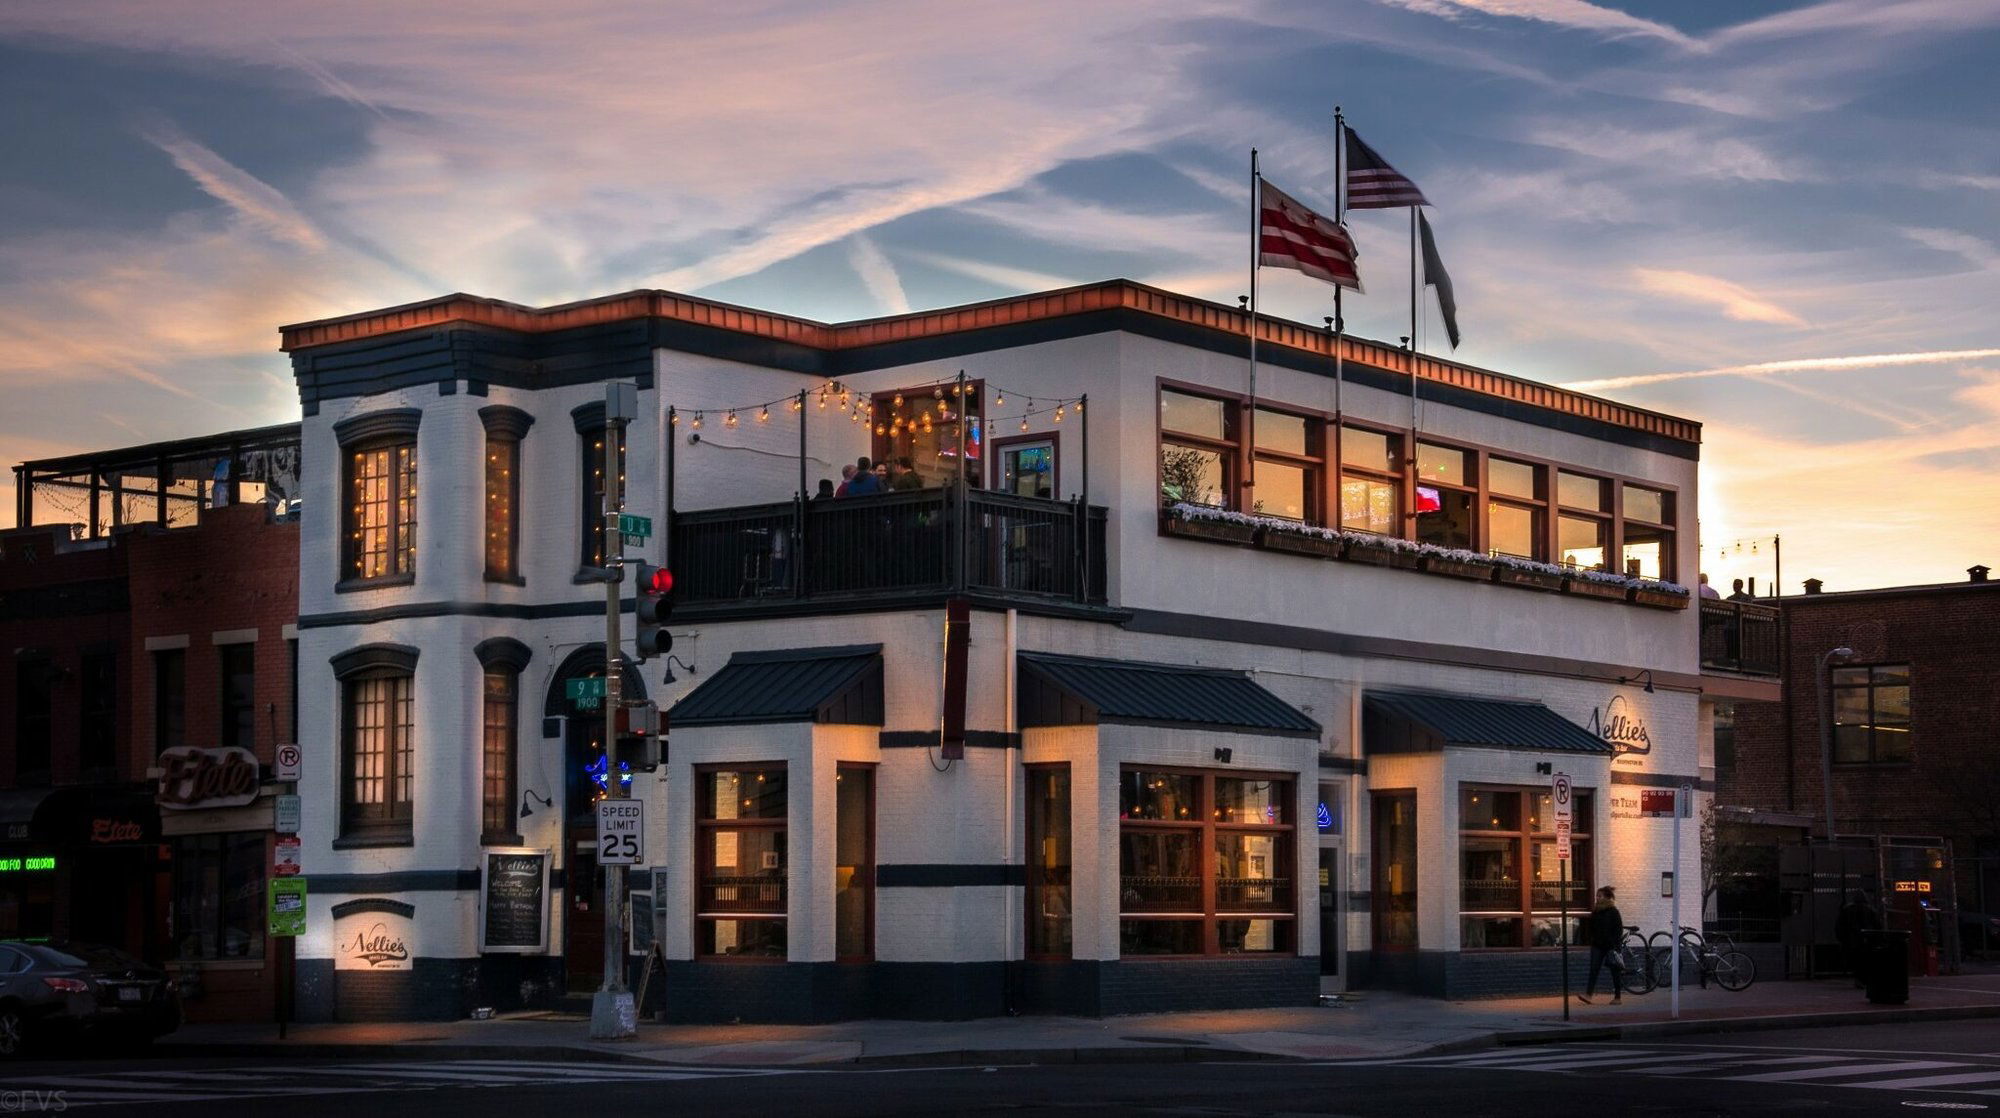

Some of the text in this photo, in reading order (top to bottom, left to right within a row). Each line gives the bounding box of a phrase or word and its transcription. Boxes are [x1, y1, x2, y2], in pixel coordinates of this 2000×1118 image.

[627, 517, 634, 532] U
[628, 534, 641, 547] 900
[578, 681, 585, 696] 9
[577, 696, 598, 709] 1900
[1587, 695, 1650, 741] Nellie's
[602, 807, 640, 817] SPEED
[90, 817, 143, 844] Etete
[606, 820, 636, 831] LIMIT
[602, 834, 638, 858] 25
[342, 923, 408, 953] Nellie's
